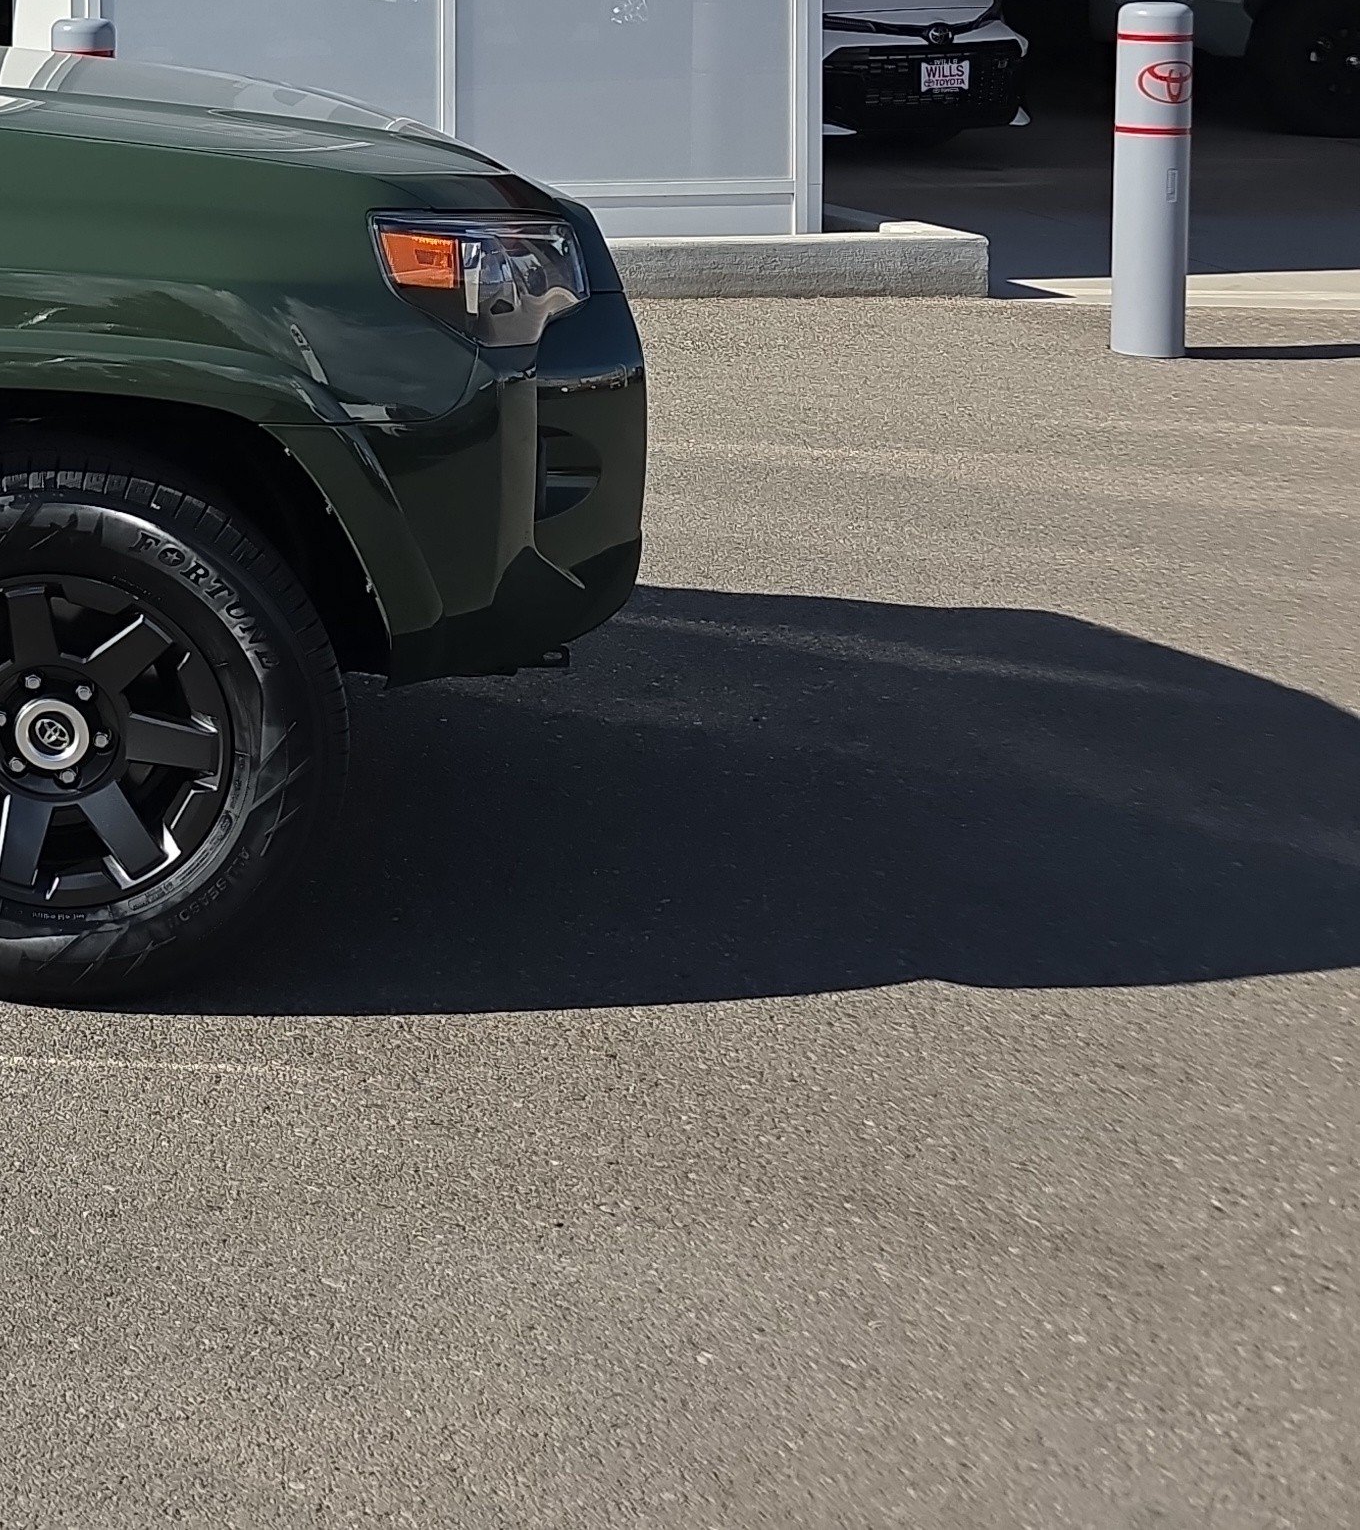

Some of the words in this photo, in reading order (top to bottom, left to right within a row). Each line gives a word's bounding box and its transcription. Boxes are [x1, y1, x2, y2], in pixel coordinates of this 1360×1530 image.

[924, 64, 965, 78] WILLS
[935, 78, 965, 86] TOYOTA
[127, 528, 282, 672] FORTUNE
